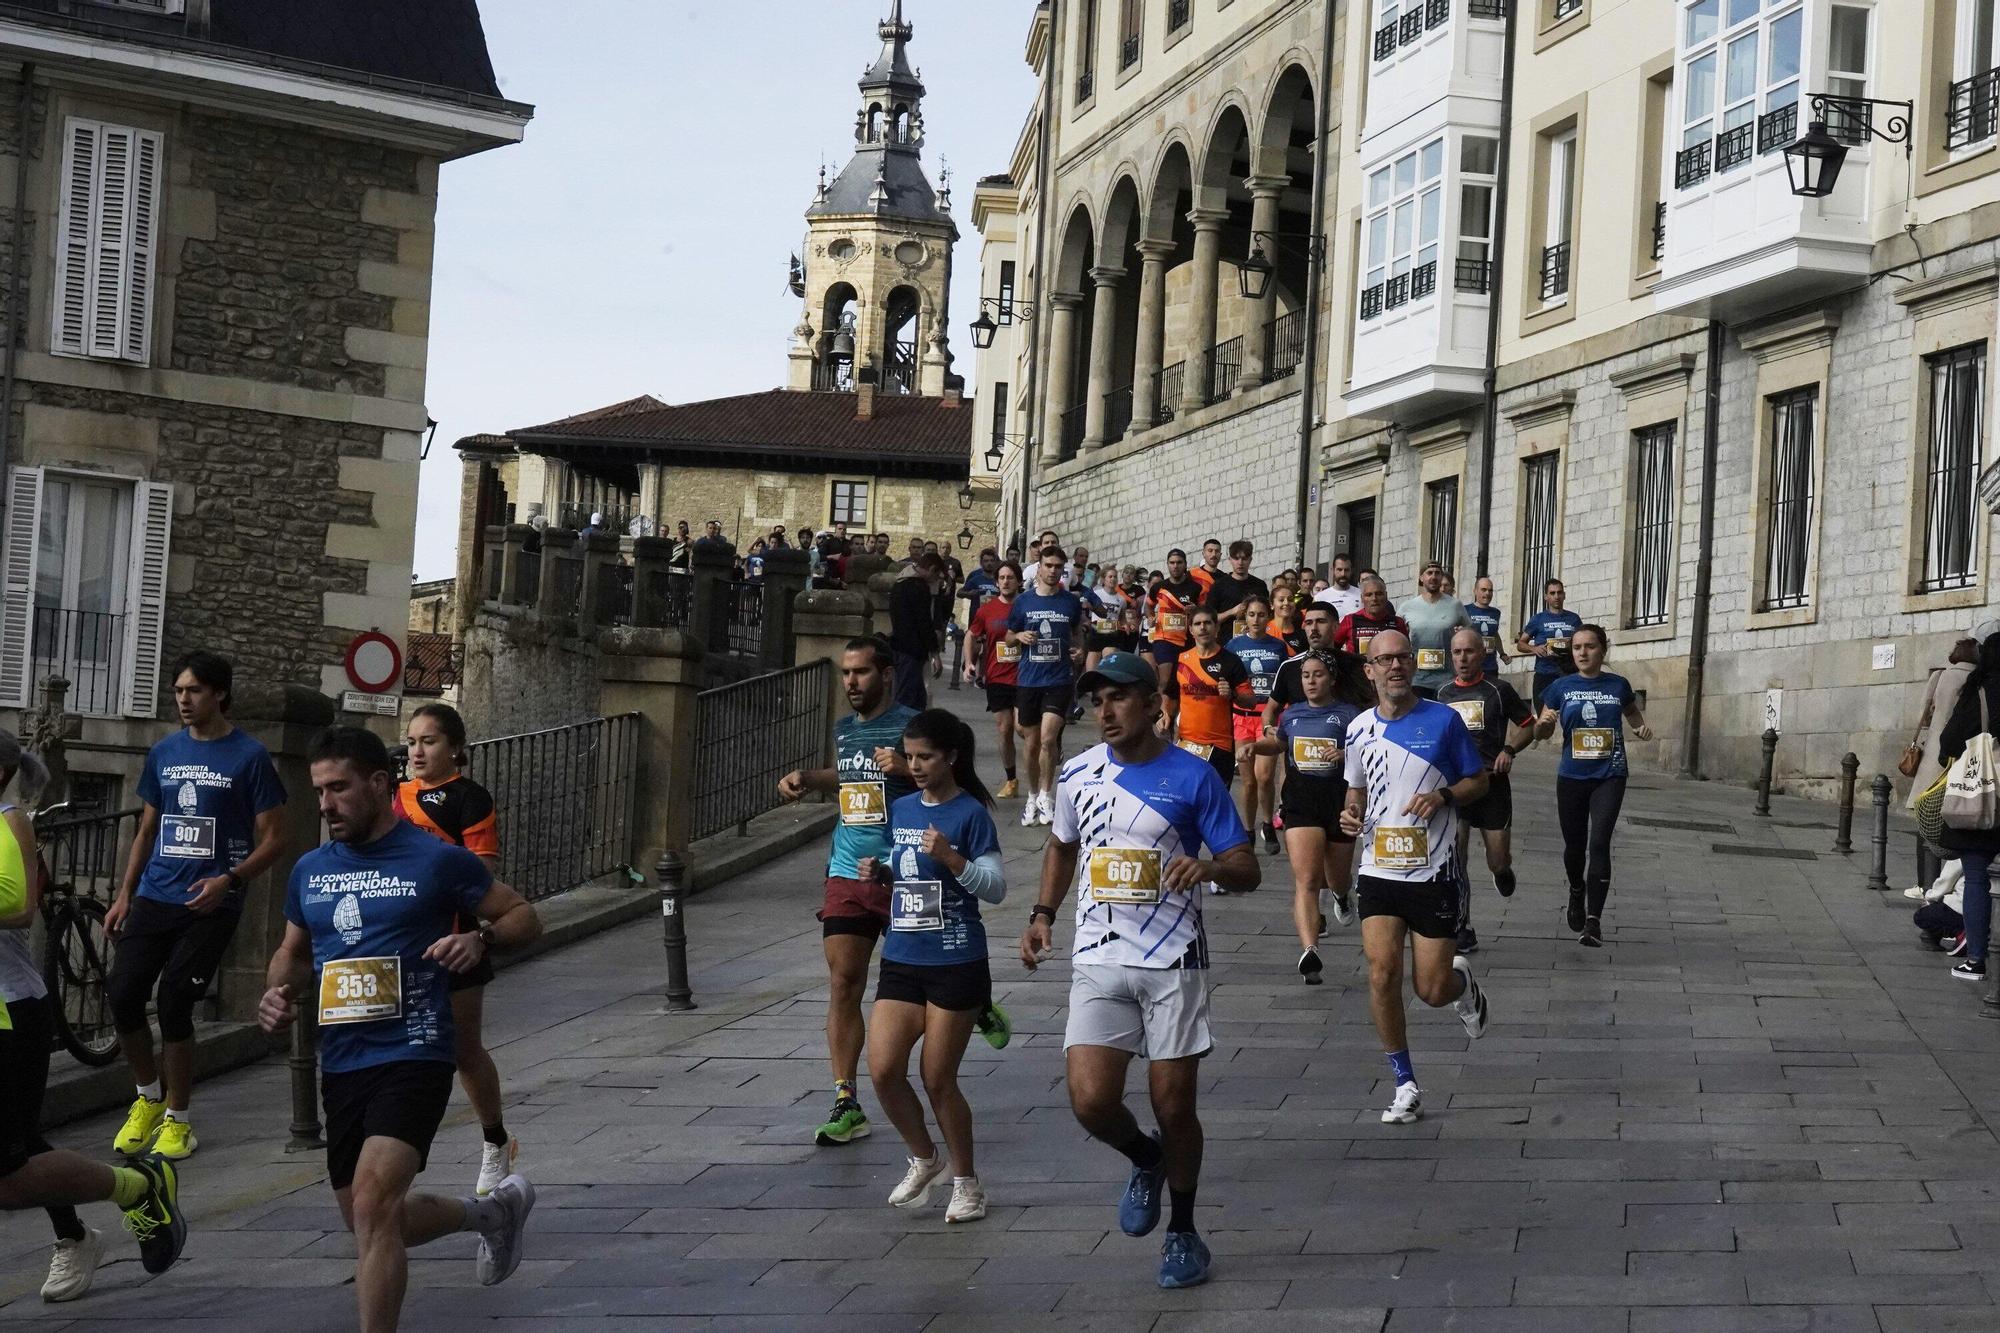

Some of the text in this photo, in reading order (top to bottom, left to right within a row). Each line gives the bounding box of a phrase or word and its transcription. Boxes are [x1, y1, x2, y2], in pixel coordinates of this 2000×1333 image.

[1582, 735, 1604, 748] 663
[169, 771, 222, 780] ALMENDRA
[862, 771, 887, 780] TRAIL
[196, 780, 232, 789] KONKISTA
[848, 793, 870, 809] 247
[175, 826, 200, 842] 907
[1385, 836, 1414, 853] 683
[309, 871, 380, 884] LA CONQUISTA
[1107, 861, 1143, 882] 667
[320, 876, 401, 893] ALMENDRA
[360, 887, 417, 899] KONKISTA
[900, 894, 924, 912] 795
[336, 974, 378, 999] 353
